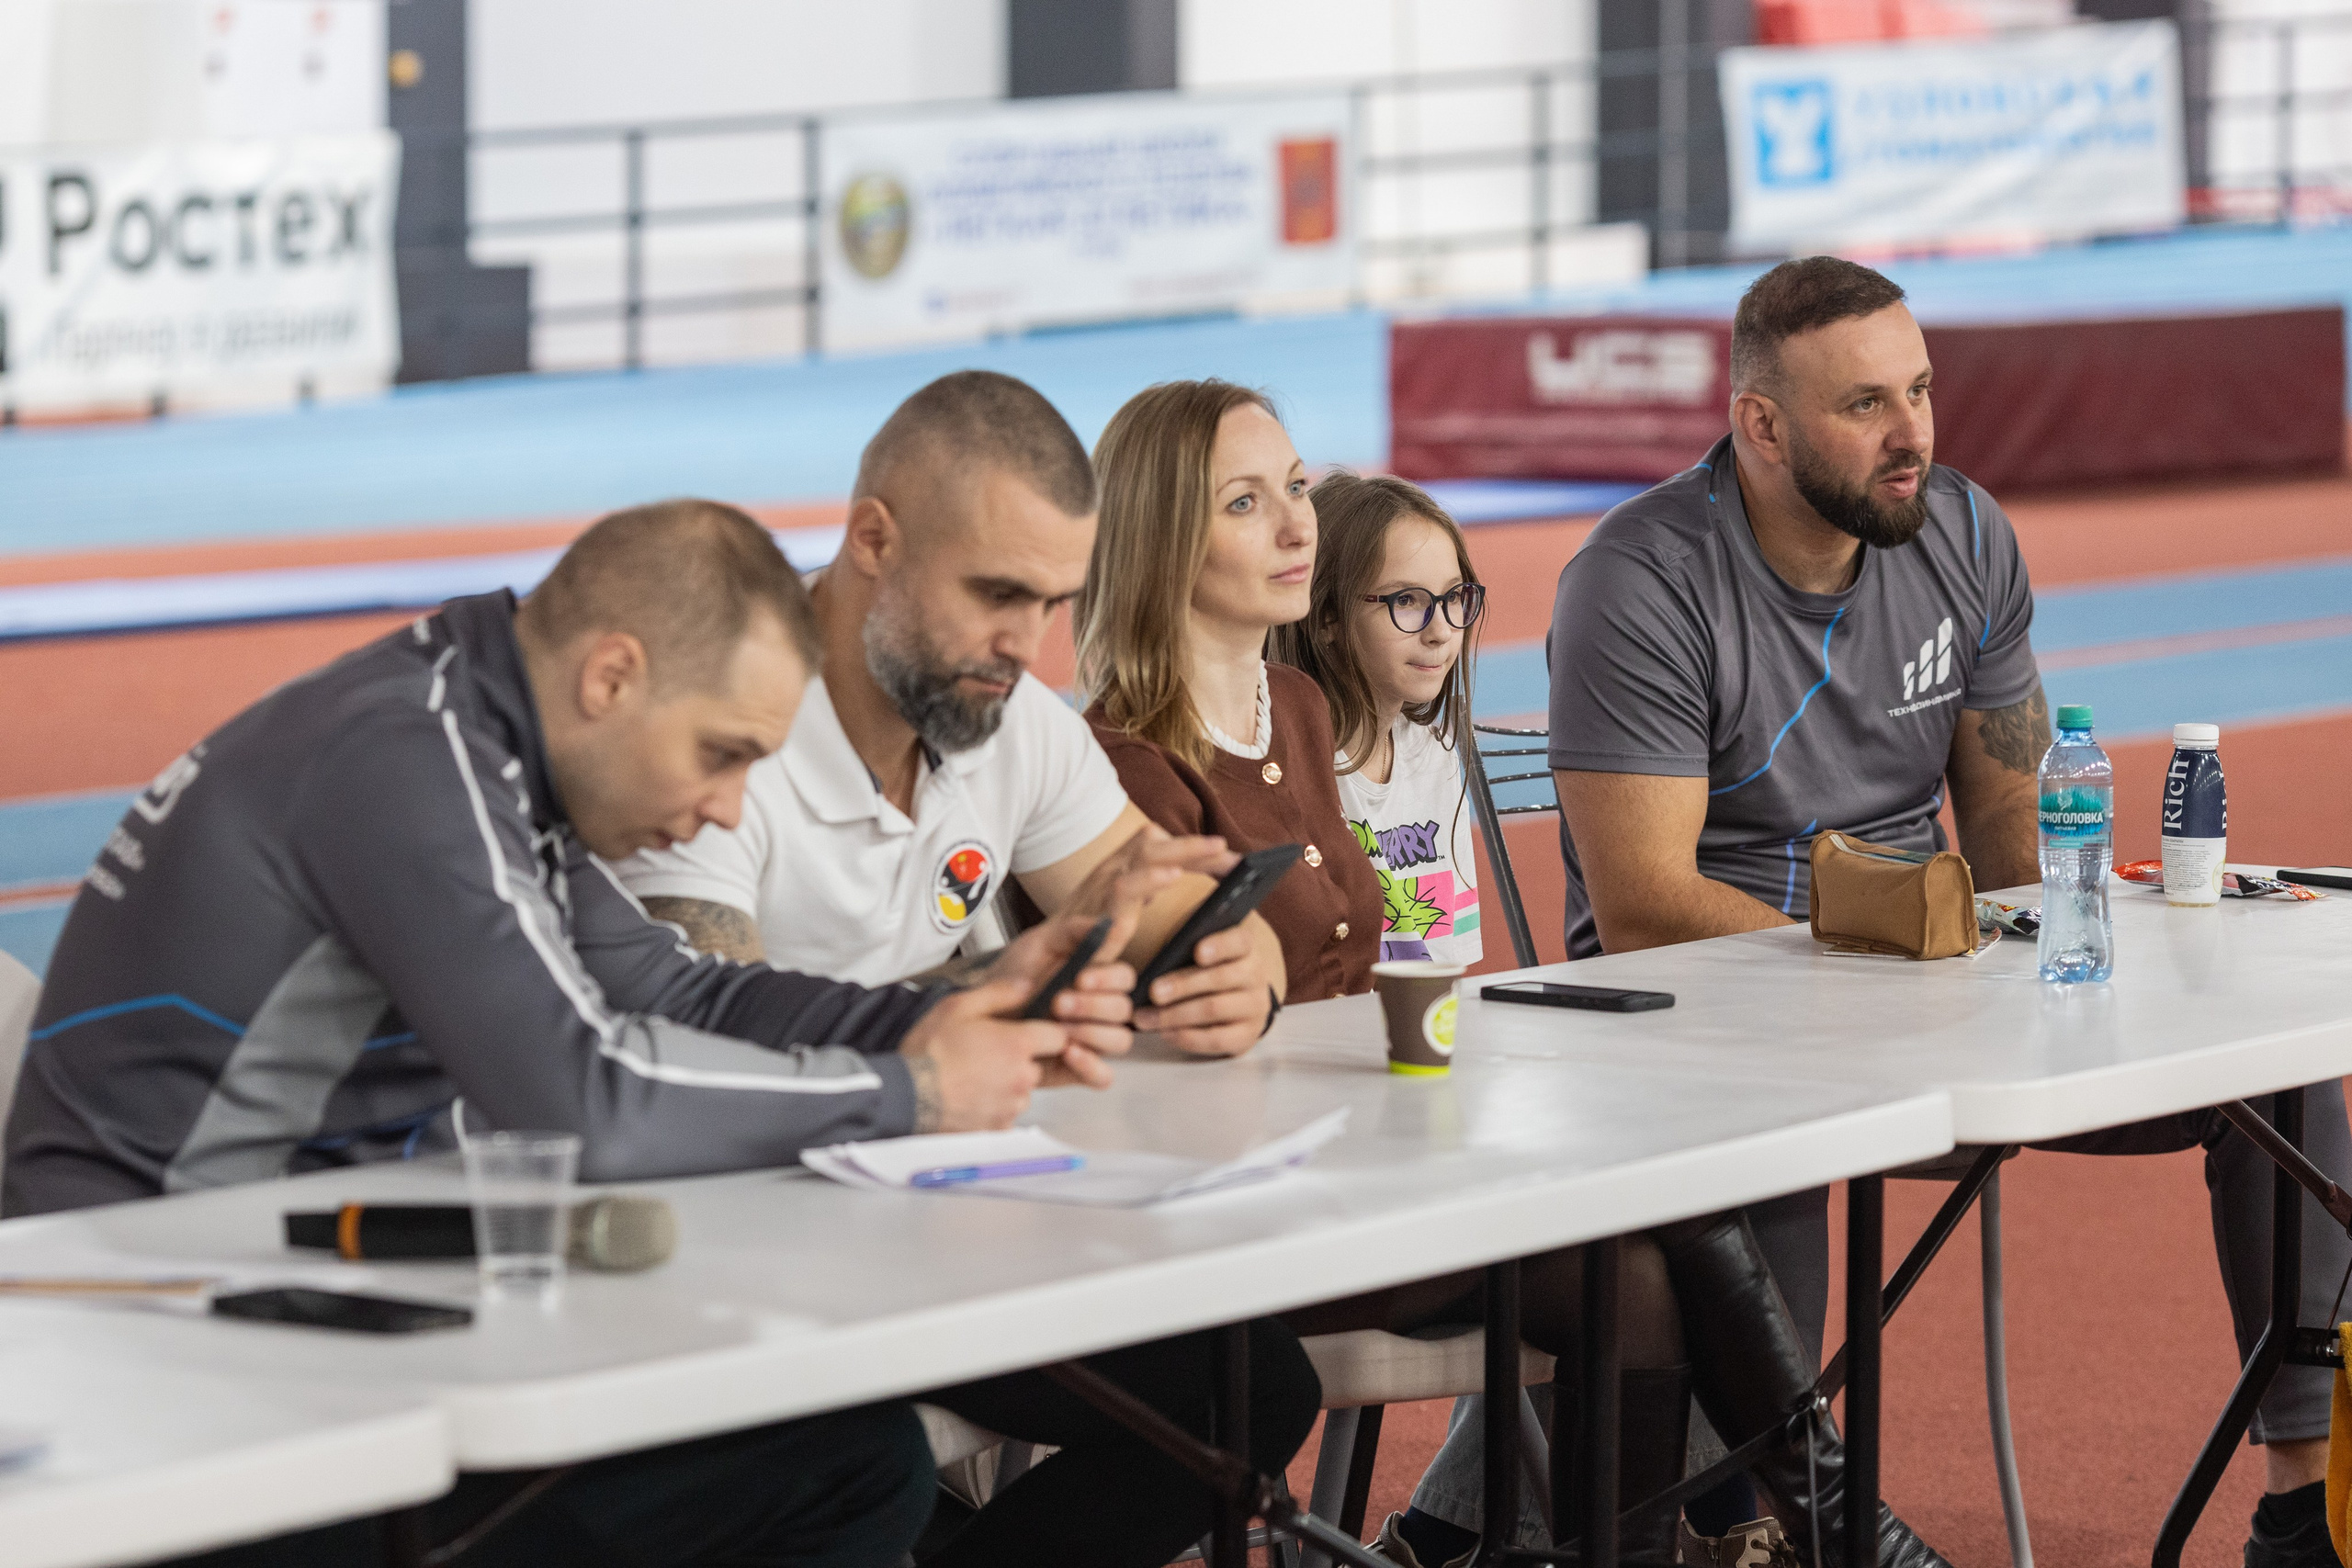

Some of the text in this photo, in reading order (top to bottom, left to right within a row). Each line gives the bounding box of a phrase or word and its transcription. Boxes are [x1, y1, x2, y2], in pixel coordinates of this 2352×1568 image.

[46, 167, 371, 281] Ростех
[2039, 811, 2104, 824] ЕРНОГОЛОВКА
[2164, 760, 2189, 830] Rich
